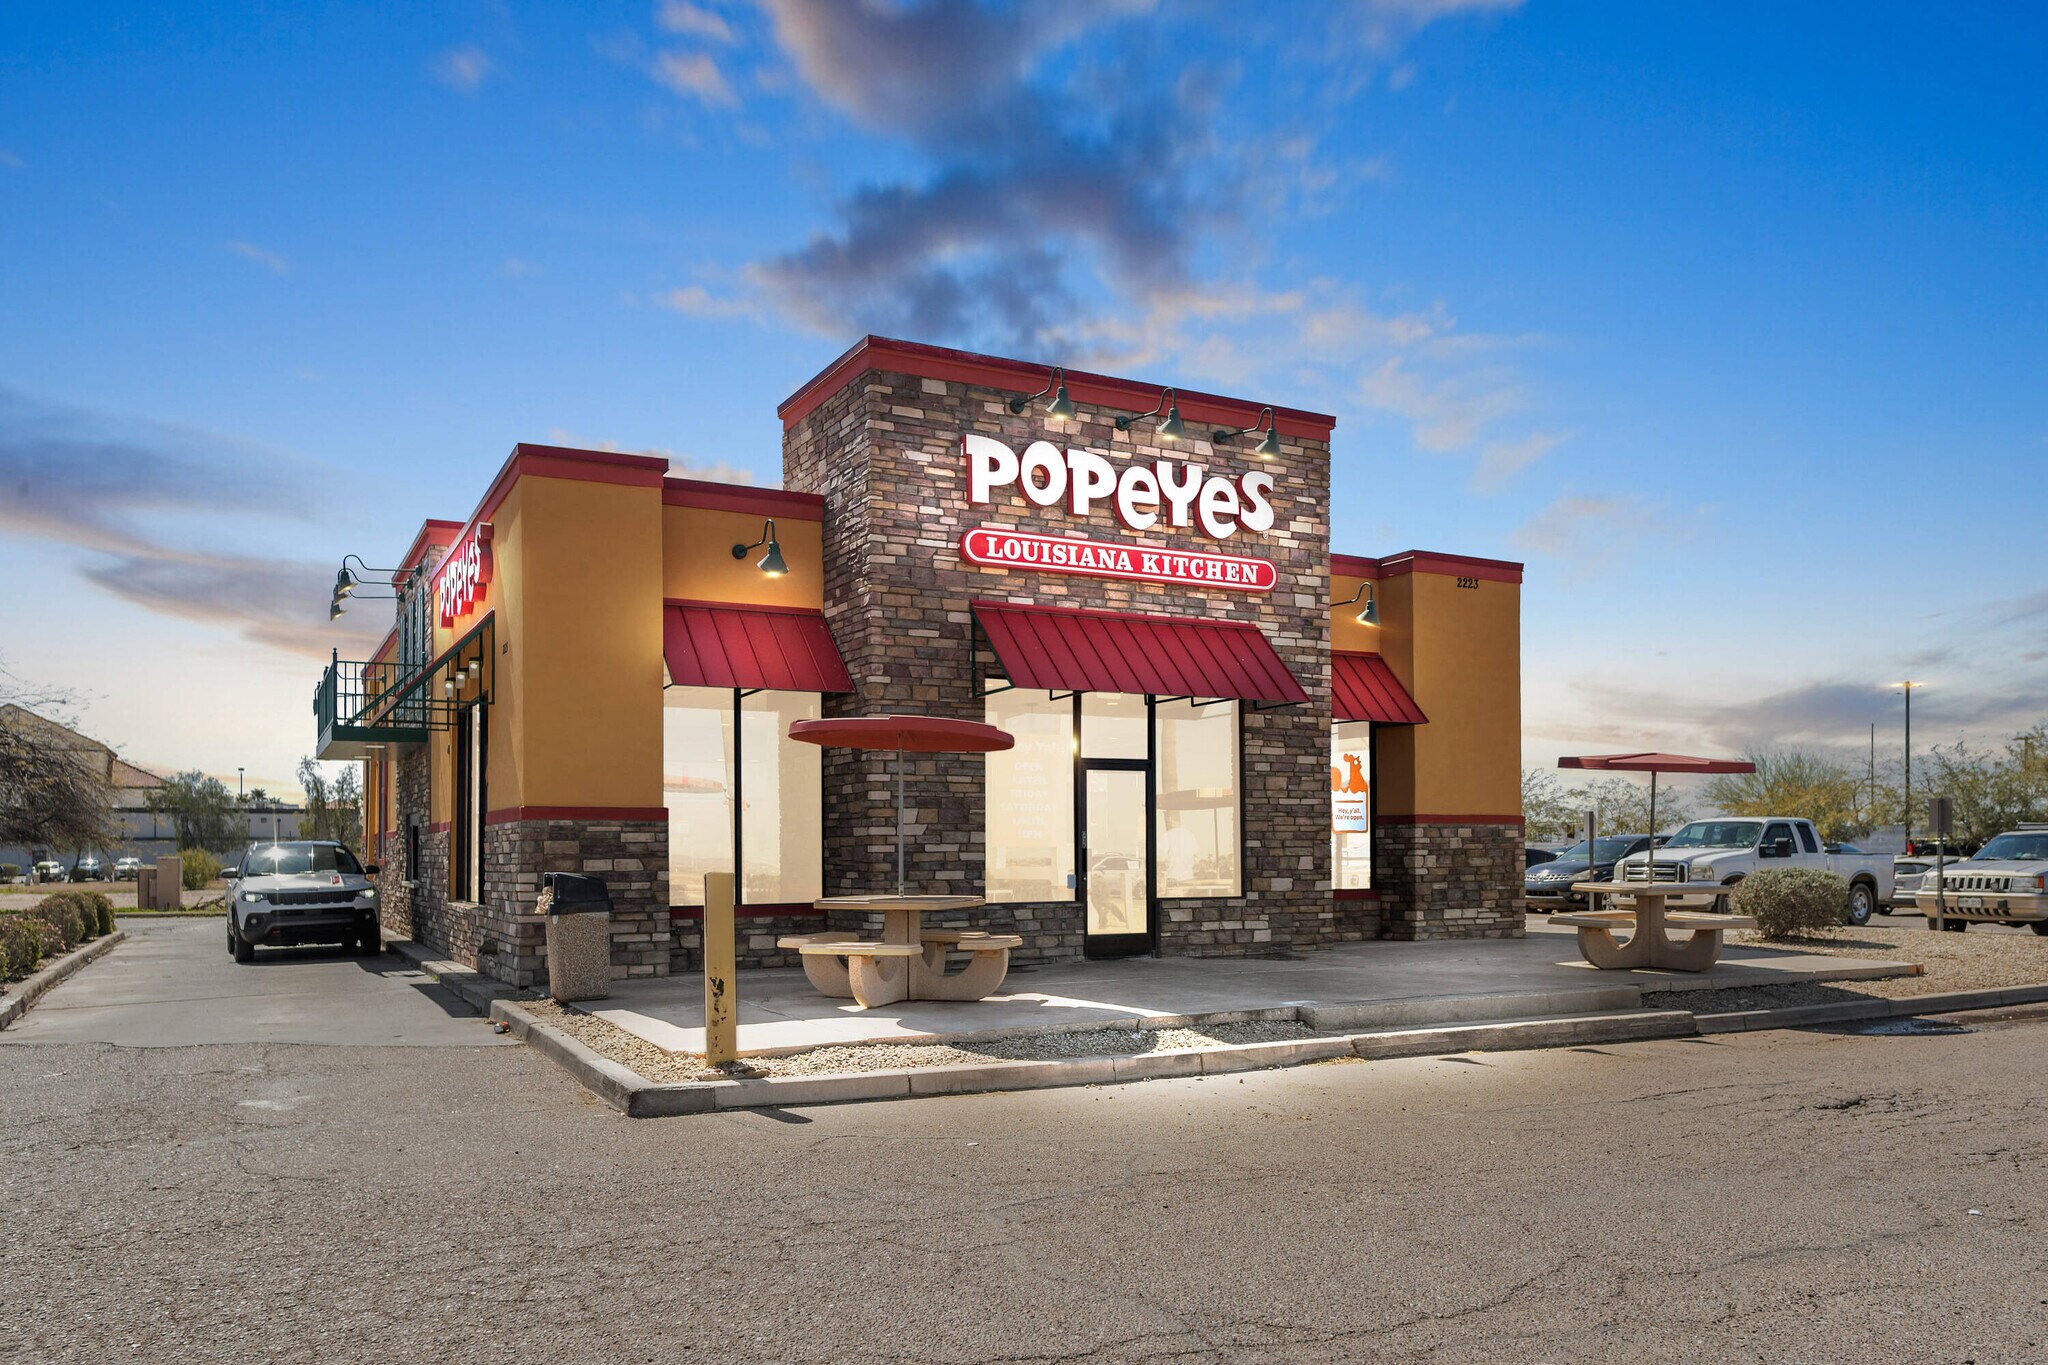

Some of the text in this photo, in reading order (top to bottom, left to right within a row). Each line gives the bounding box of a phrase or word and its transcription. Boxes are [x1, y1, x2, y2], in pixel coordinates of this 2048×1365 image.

[986, 536, 1259, 584] LOUISIANA KITCHEN
[1456, 577, 1479, 590] 2223
